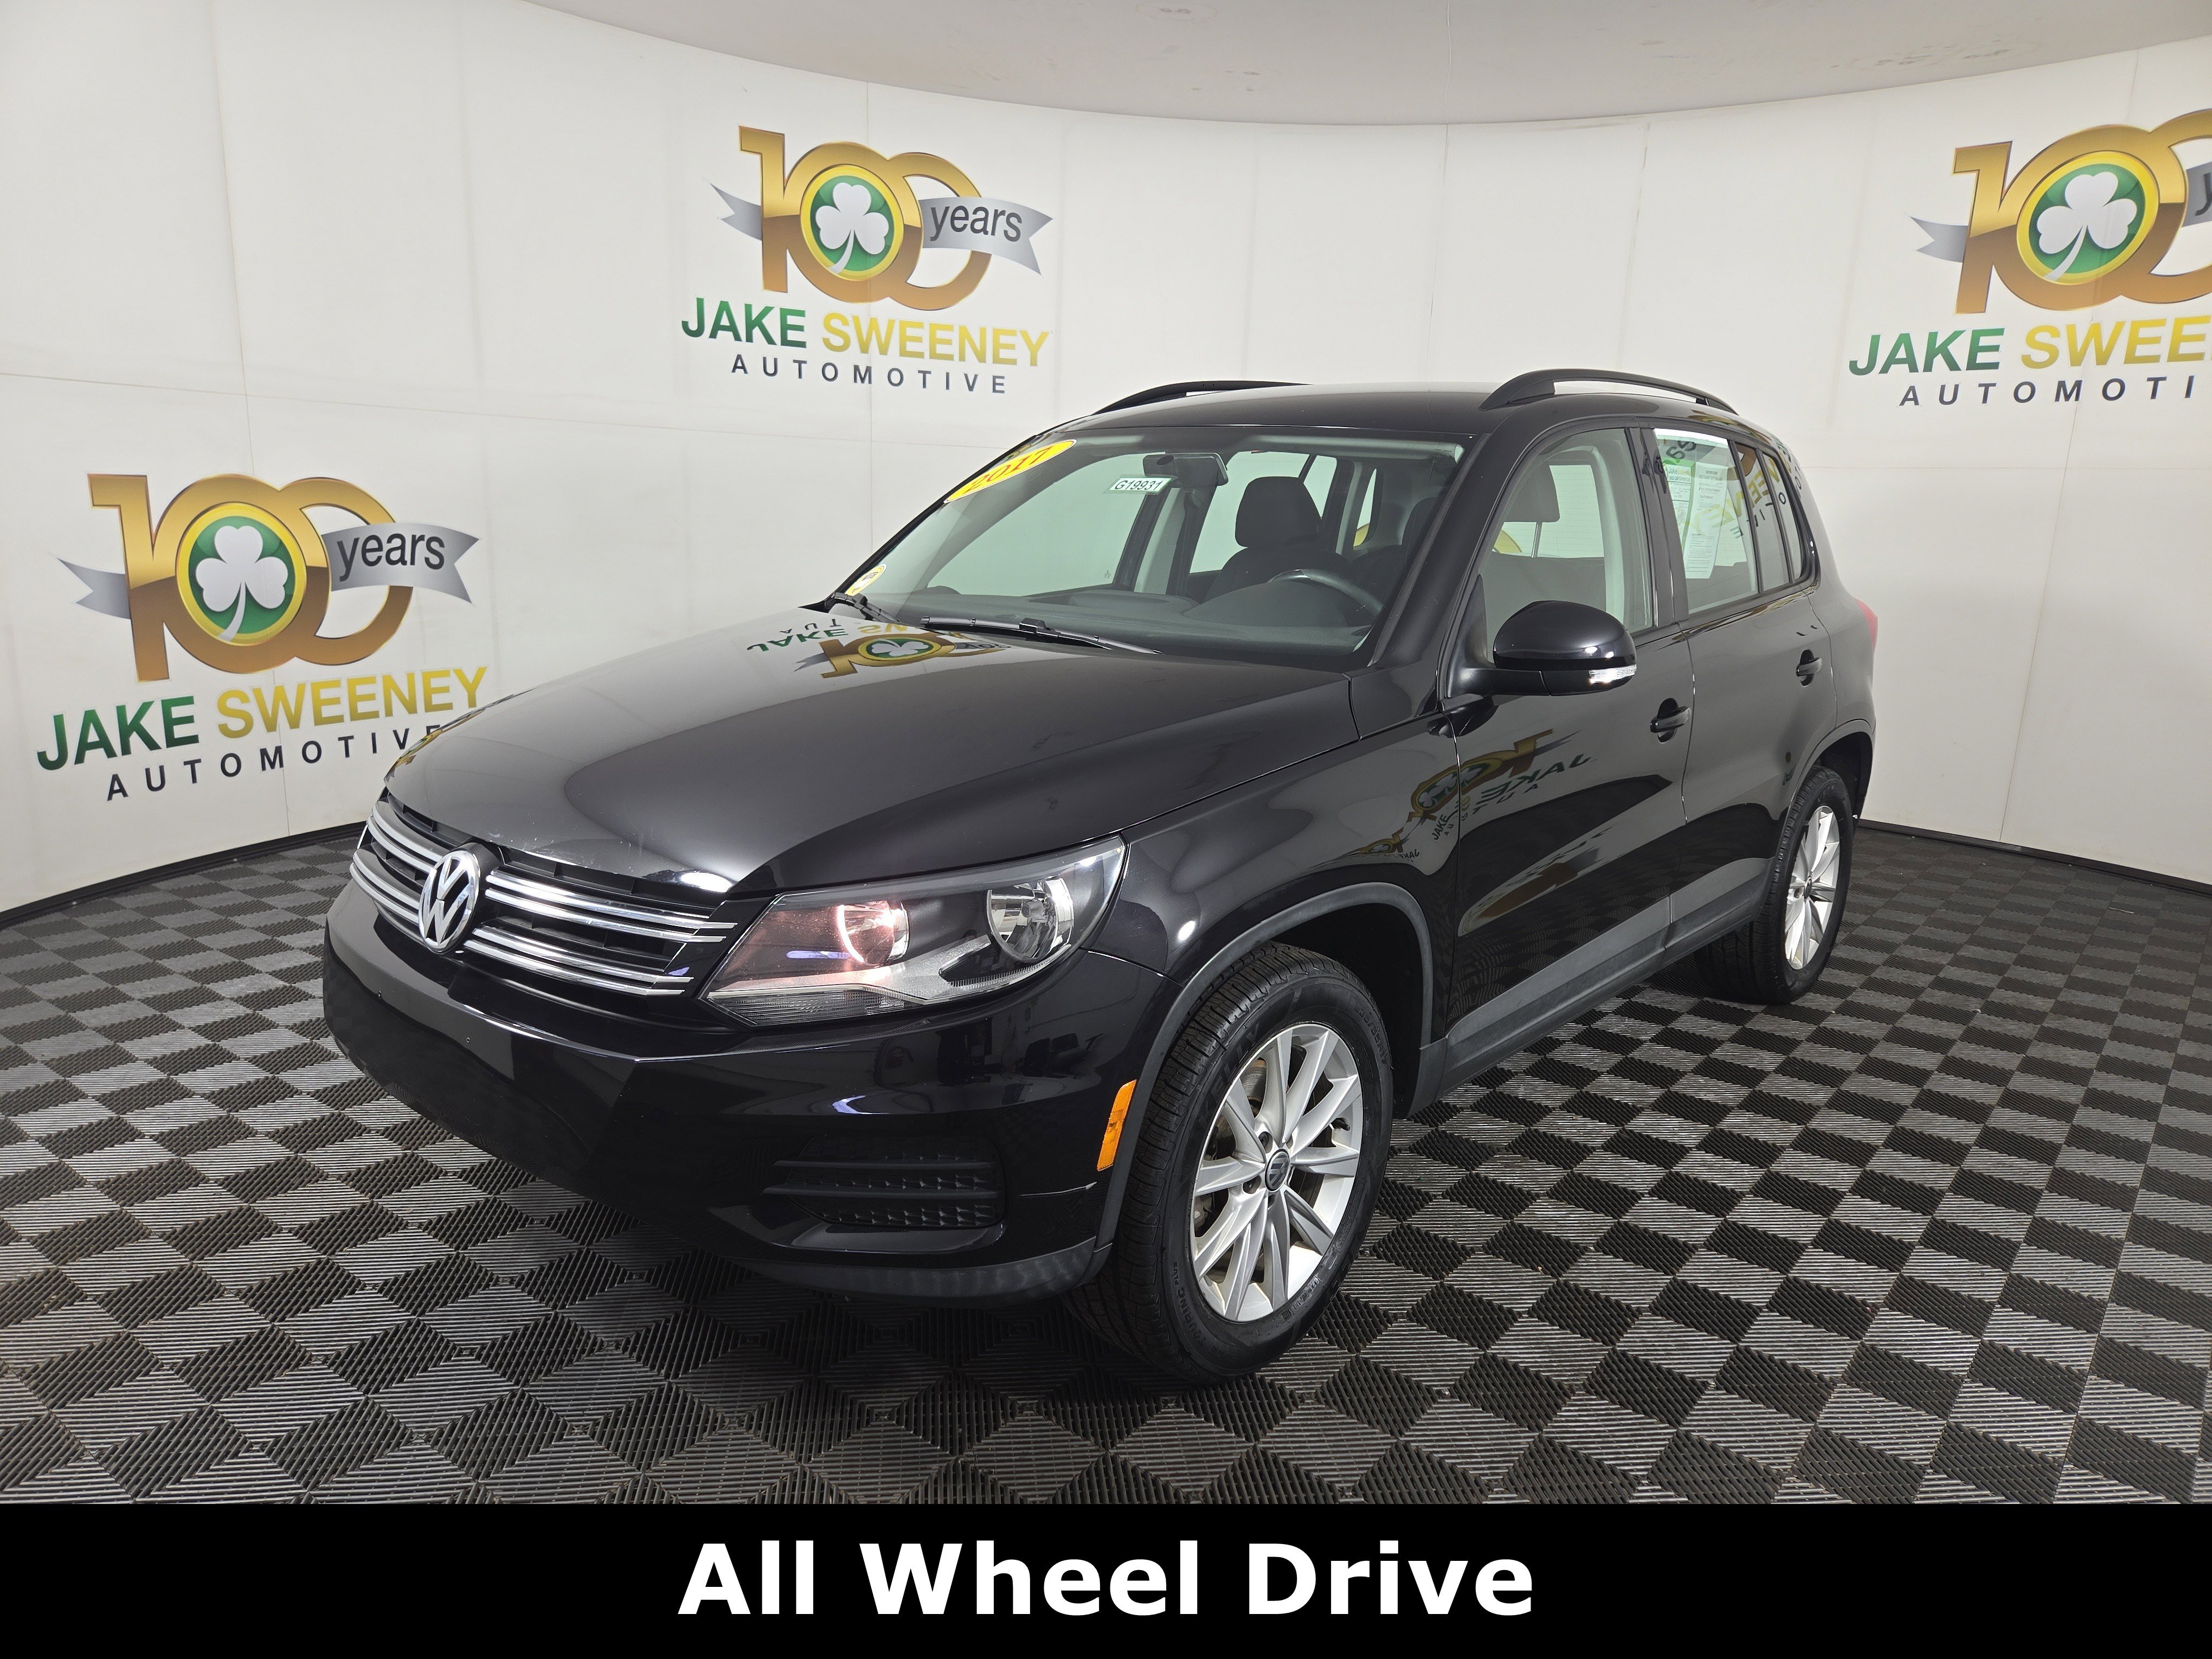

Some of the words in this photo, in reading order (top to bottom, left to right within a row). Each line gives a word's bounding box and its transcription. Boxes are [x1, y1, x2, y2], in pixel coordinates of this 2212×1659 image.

[738, 125, 992, 312] 100
[929, 205, 1023, 242] years
[681, 297, 807, 349] JAKE
[822, 312, 1049, 368] SWEENEY
[1848, 327, 2005, 376] JAKE
[2021, 315, 2212, 369] SWEE
[731, 353, 1006, 394] AUTOMOTIVE
[962, 446, 1054, 494] 2017
[1114, 480, 1163, 491] G19931
[87, 473, 414, 684] 100
[337, 532, 446, 583] years
[36, 695, 201, 771] JAKE
[217, 666, 488, 739] SWEENEY
